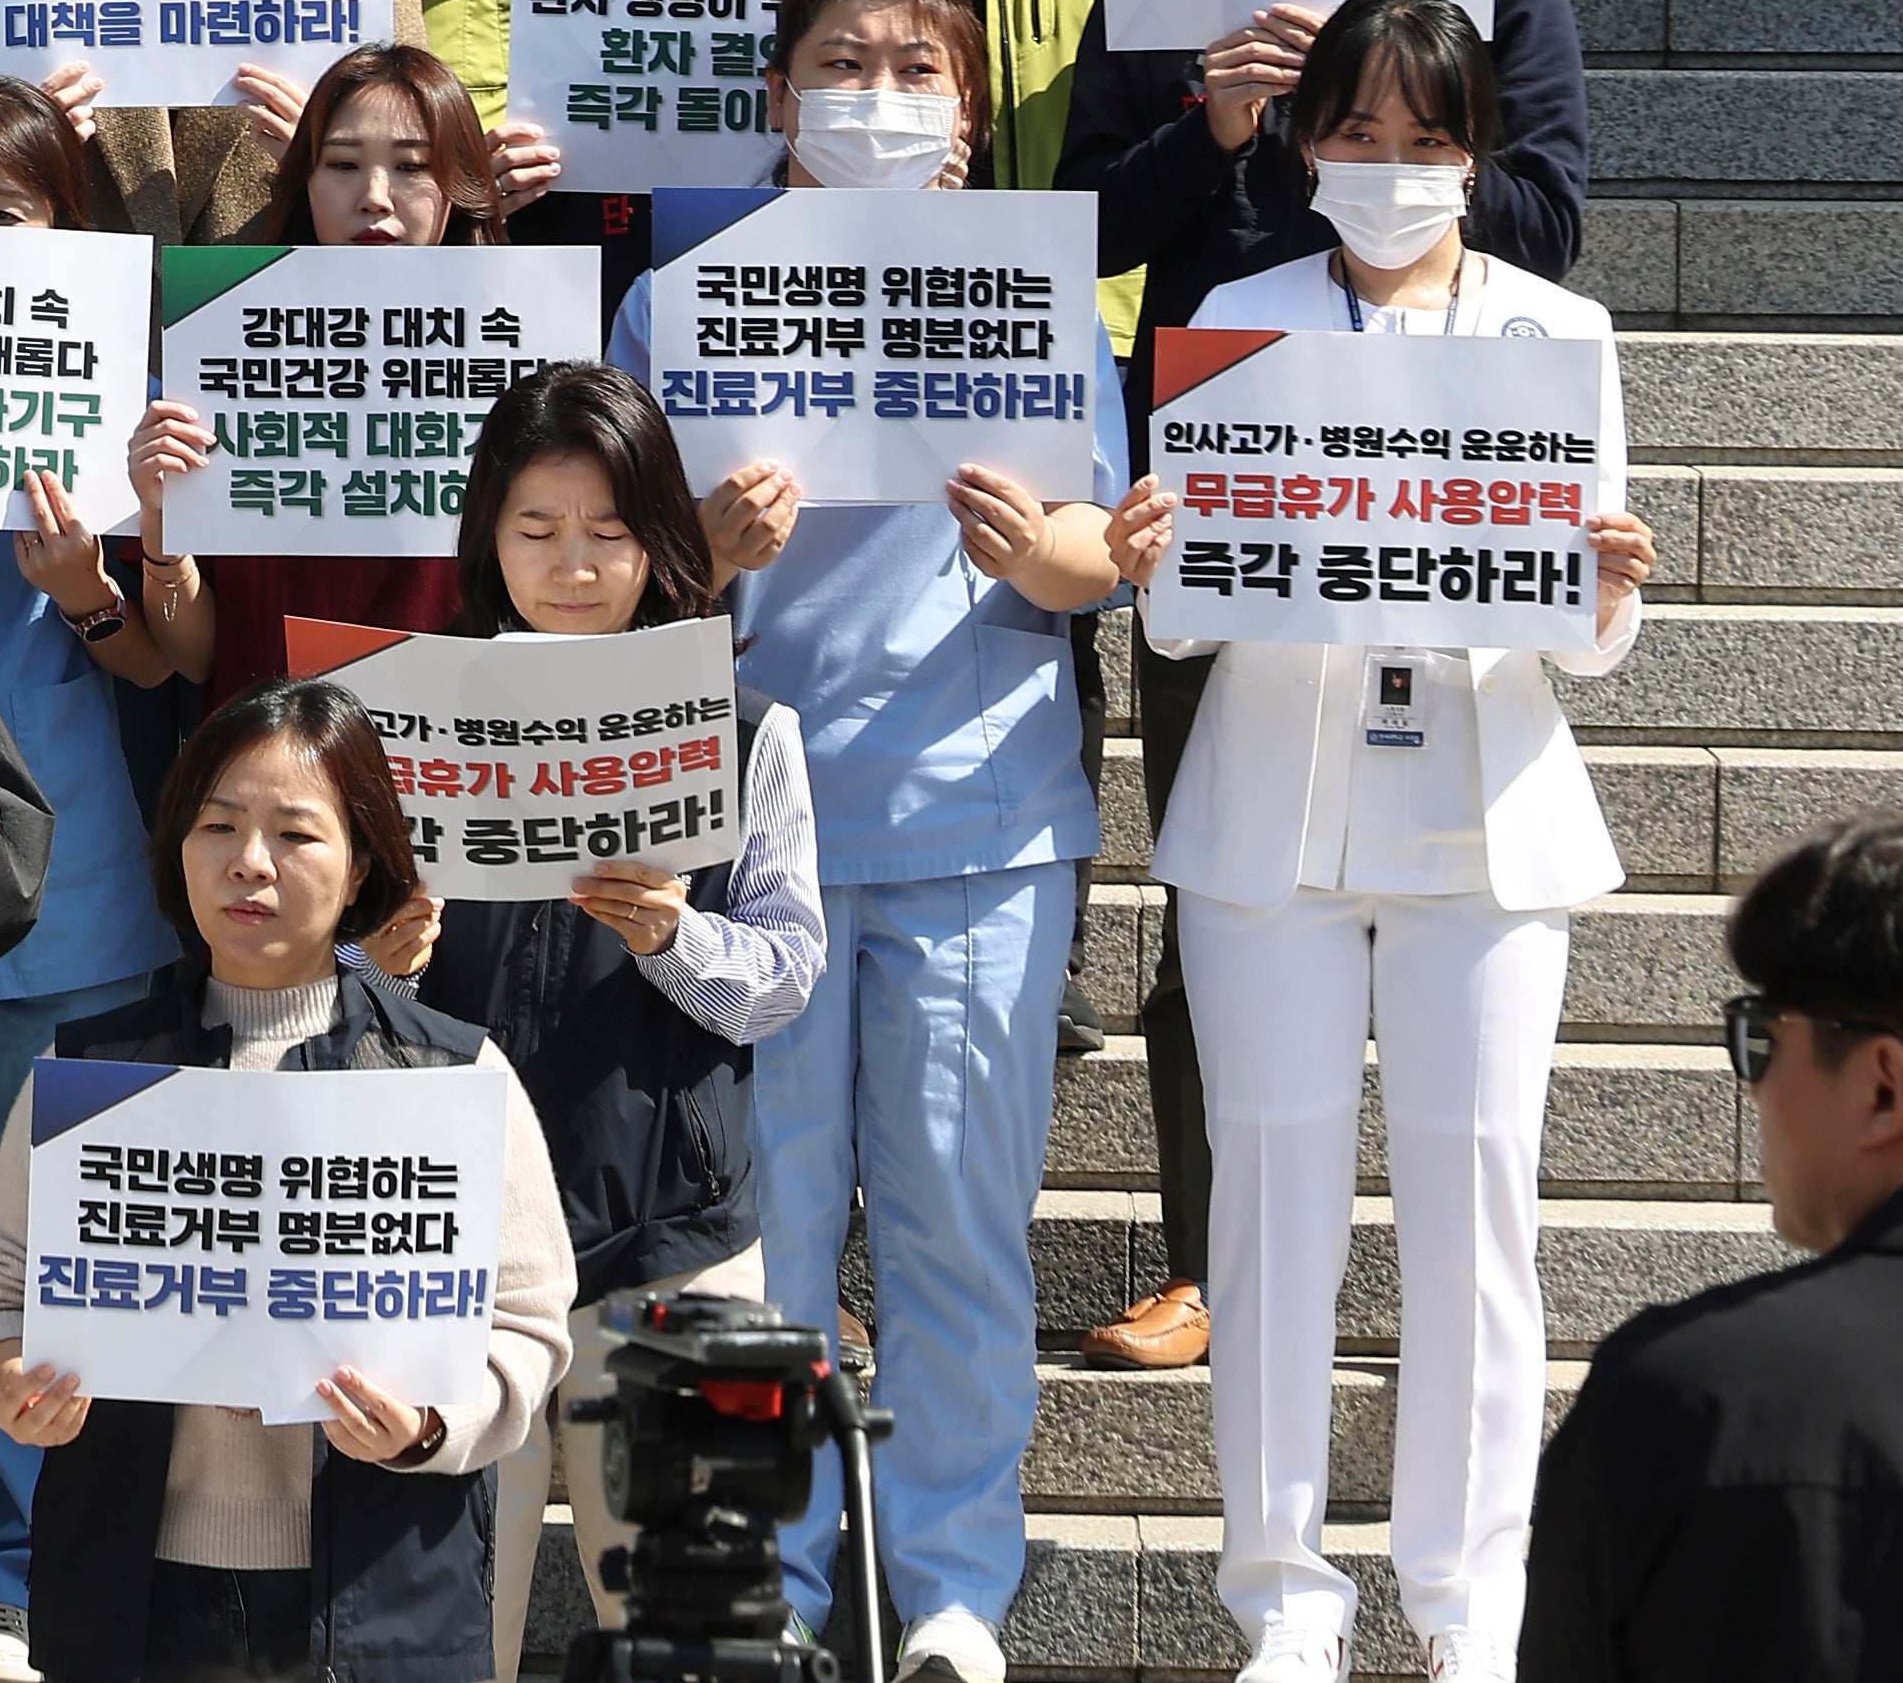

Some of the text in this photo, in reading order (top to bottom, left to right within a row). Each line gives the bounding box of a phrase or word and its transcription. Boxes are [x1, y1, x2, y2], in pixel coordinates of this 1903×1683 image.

[4, 1, 142, 49] 대책을
[696, 265, 1052, 310] 국민생명 위협하는
[696, 316, 1054, 361] 진료거부 명분없다
[661, 370, 1085, 421] 진료거부 중단하라!
[1460, 429, 1596, 464] 운운하는
[1183, 473, 1581, 527] 무급휴가 사용압력
[1178, 541, 1581, 606] 즉각 중단하라!
[597, 697, 732, 742] 운운하는
[528, 735, 721, 798] 사용압력
[461, 788, 724, 866] 중단하라!
[79, 1144, 458, 1201] 국민생명 위협하는
[77, 1199, 459, 1256] 진료거부 명분없다
[38, 1255, 488, 1321] 진료거부 중단하라!
